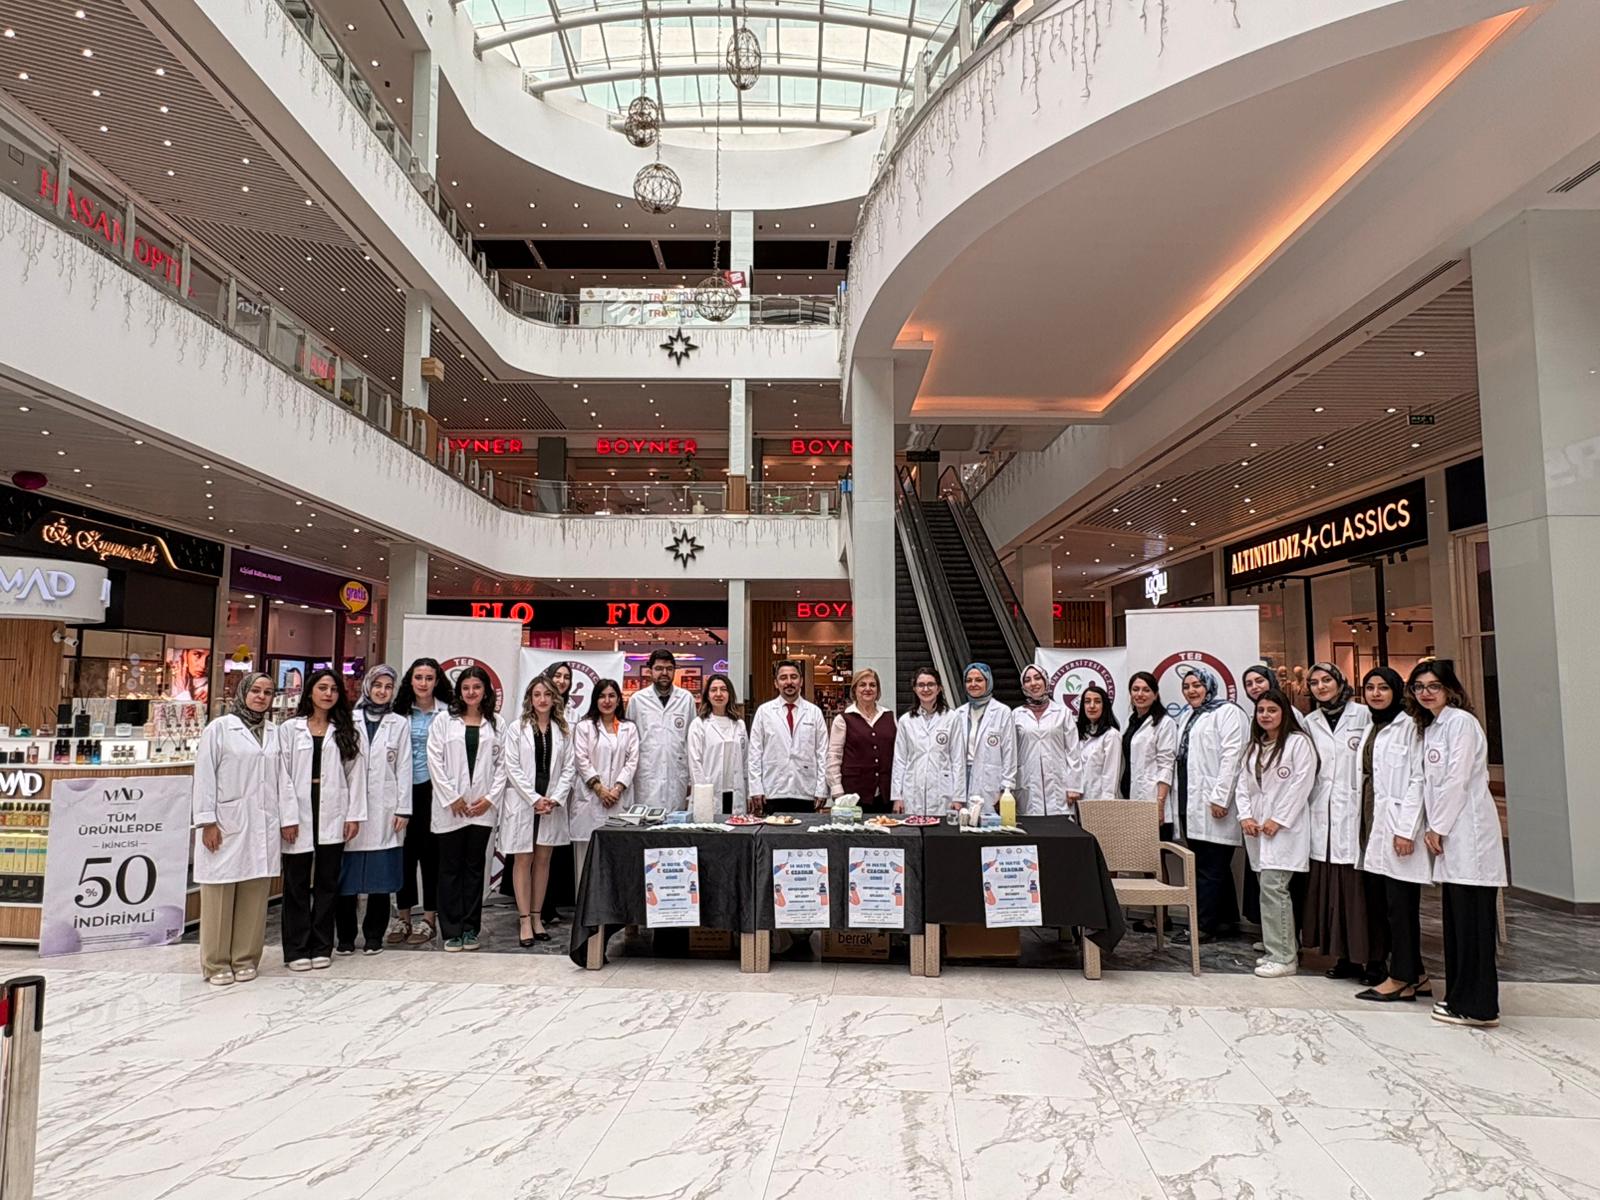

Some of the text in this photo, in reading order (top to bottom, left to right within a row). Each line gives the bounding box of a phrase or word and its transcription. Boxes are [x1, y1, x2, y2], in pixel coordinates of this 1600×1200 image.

[134, 236, 197, 298] OPTI
[596, 439, 698, 454] BOYNER
[1231, 498, 1411, 575] ALTINYILDIZ CLASSICS
[471, 602, 534, 625] FLO
[606, 602, 670, 625] FLO
[797, 603, 854, 617] BOY
[1179, 652, 1202, 660] TEB
[103, 787, 143, 801] MAD
[107, 812, 137, 823] TÜM
[78, 822, 163, 836] ÜRÜNLERDE
[74, 854, 157, 909] 50
[73, 909, 155, 929] İNDİRİMLİ
[838, 932, 873, 945] berrak
